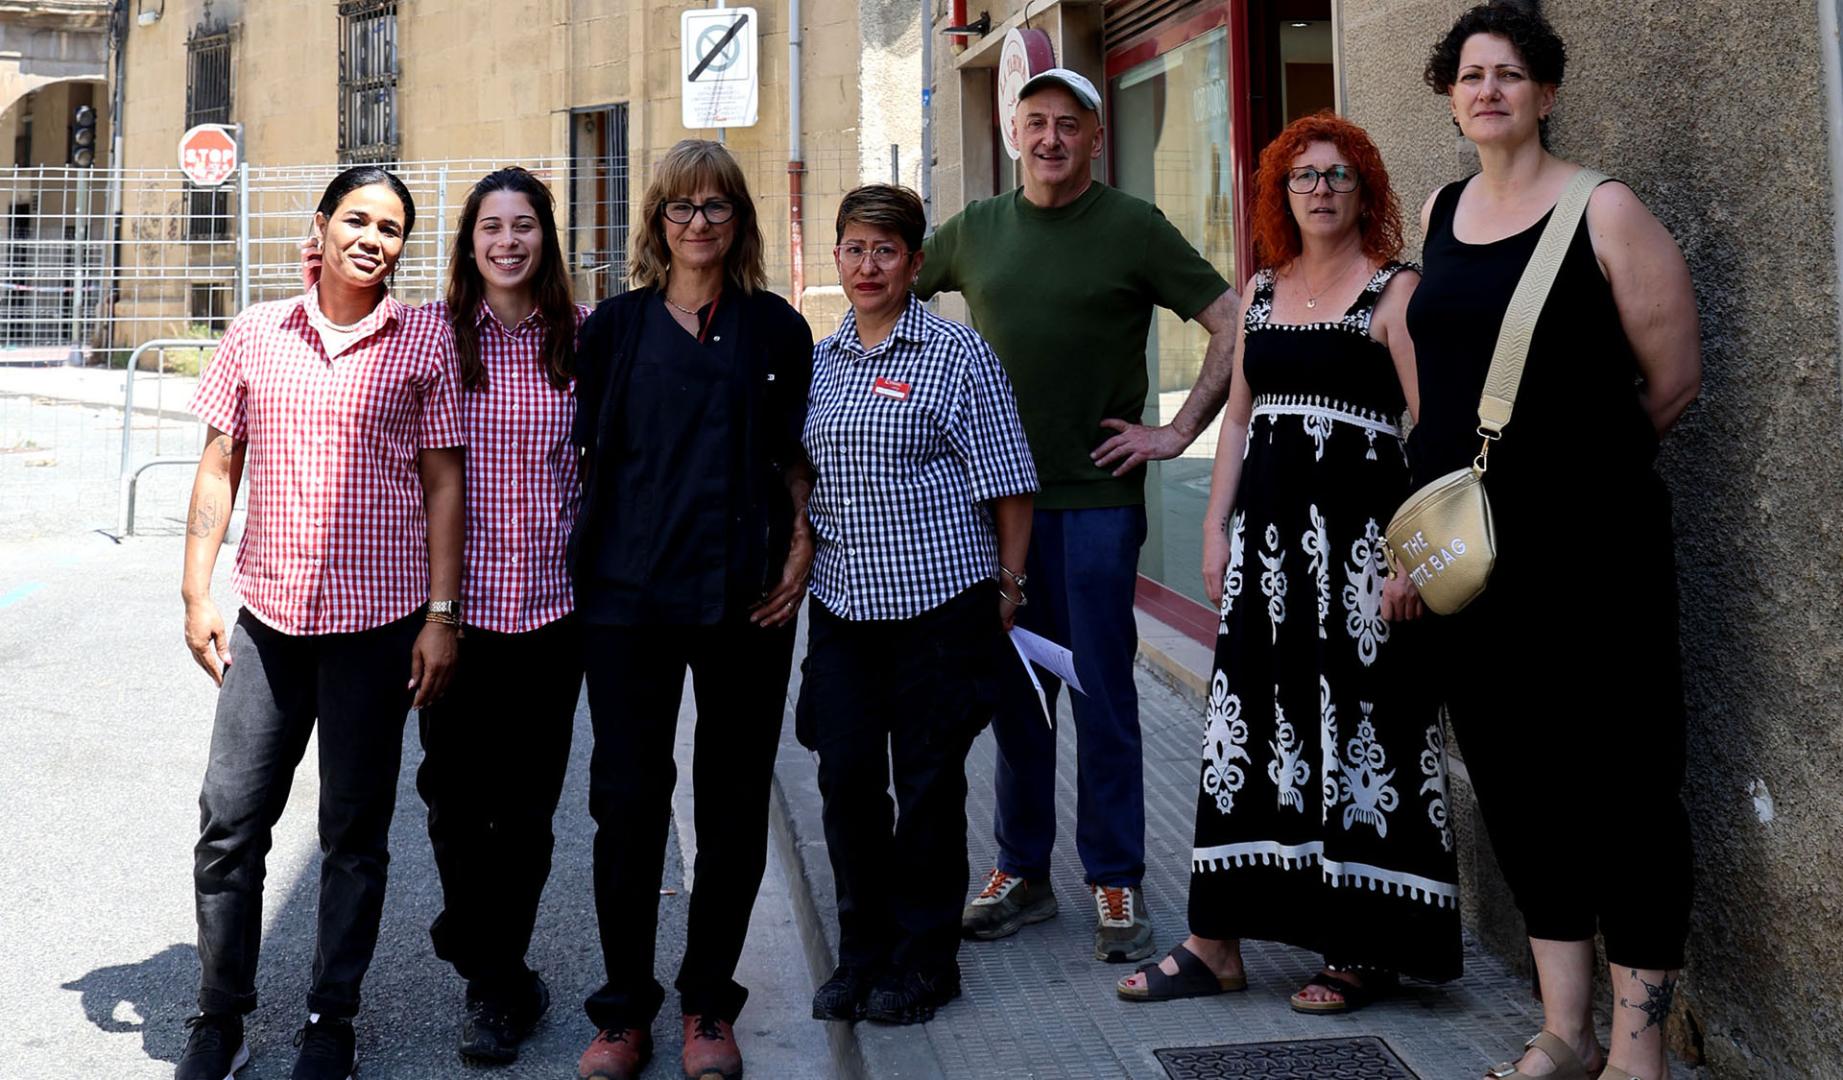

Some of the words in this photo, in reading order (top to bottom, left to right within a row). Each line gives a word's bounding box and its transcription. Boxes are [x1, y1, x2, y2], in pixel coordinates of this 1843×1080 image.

[186, 148, 233, 164] STOP
[1402, 531, 1428, 560] THE
[1428, 538, 1466, 571] BAG
